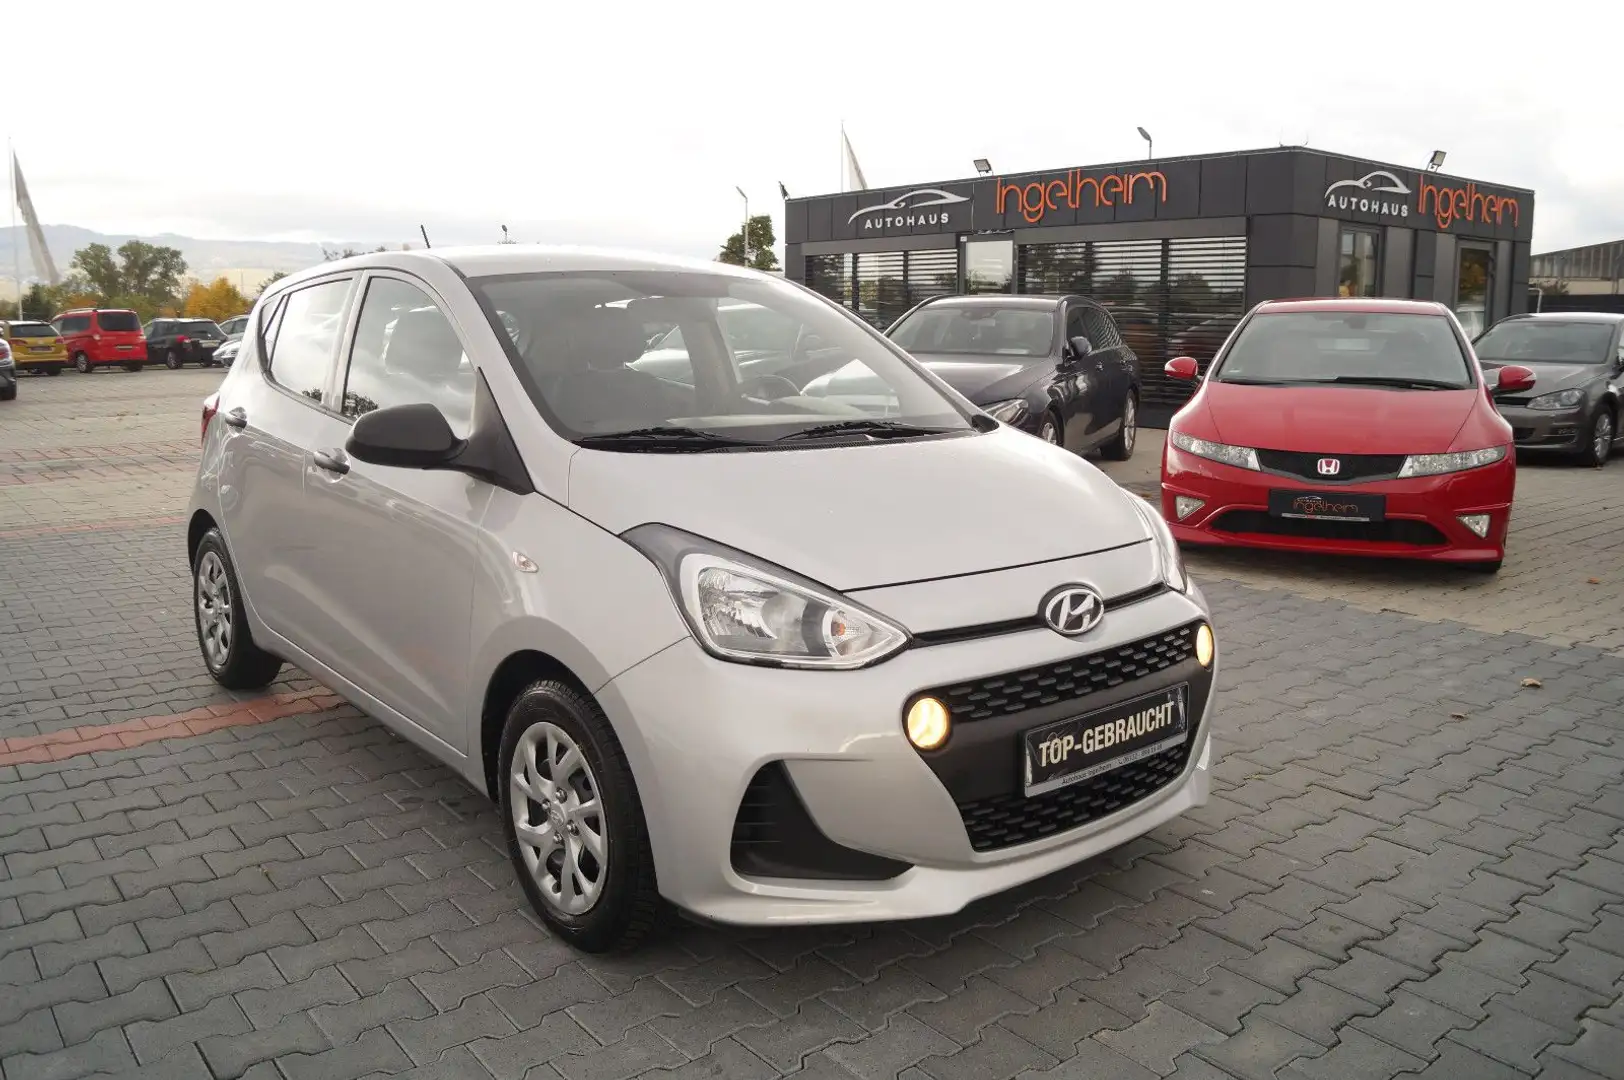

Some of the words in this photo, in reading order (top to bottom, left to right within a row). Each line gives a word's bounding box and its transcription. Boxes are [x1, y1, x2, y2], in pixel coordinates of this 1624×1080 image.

[864, 212, 950, 229] AUTOHAUS
[994, 168, 1168, 223] Ingelheim
[1327, 194, 1409, 217] AUTOHAUS
[1418, 174, 1519, 229] Ingelheim
[1038, 701, 1175, 767] TOP-GEBRAUCHT
